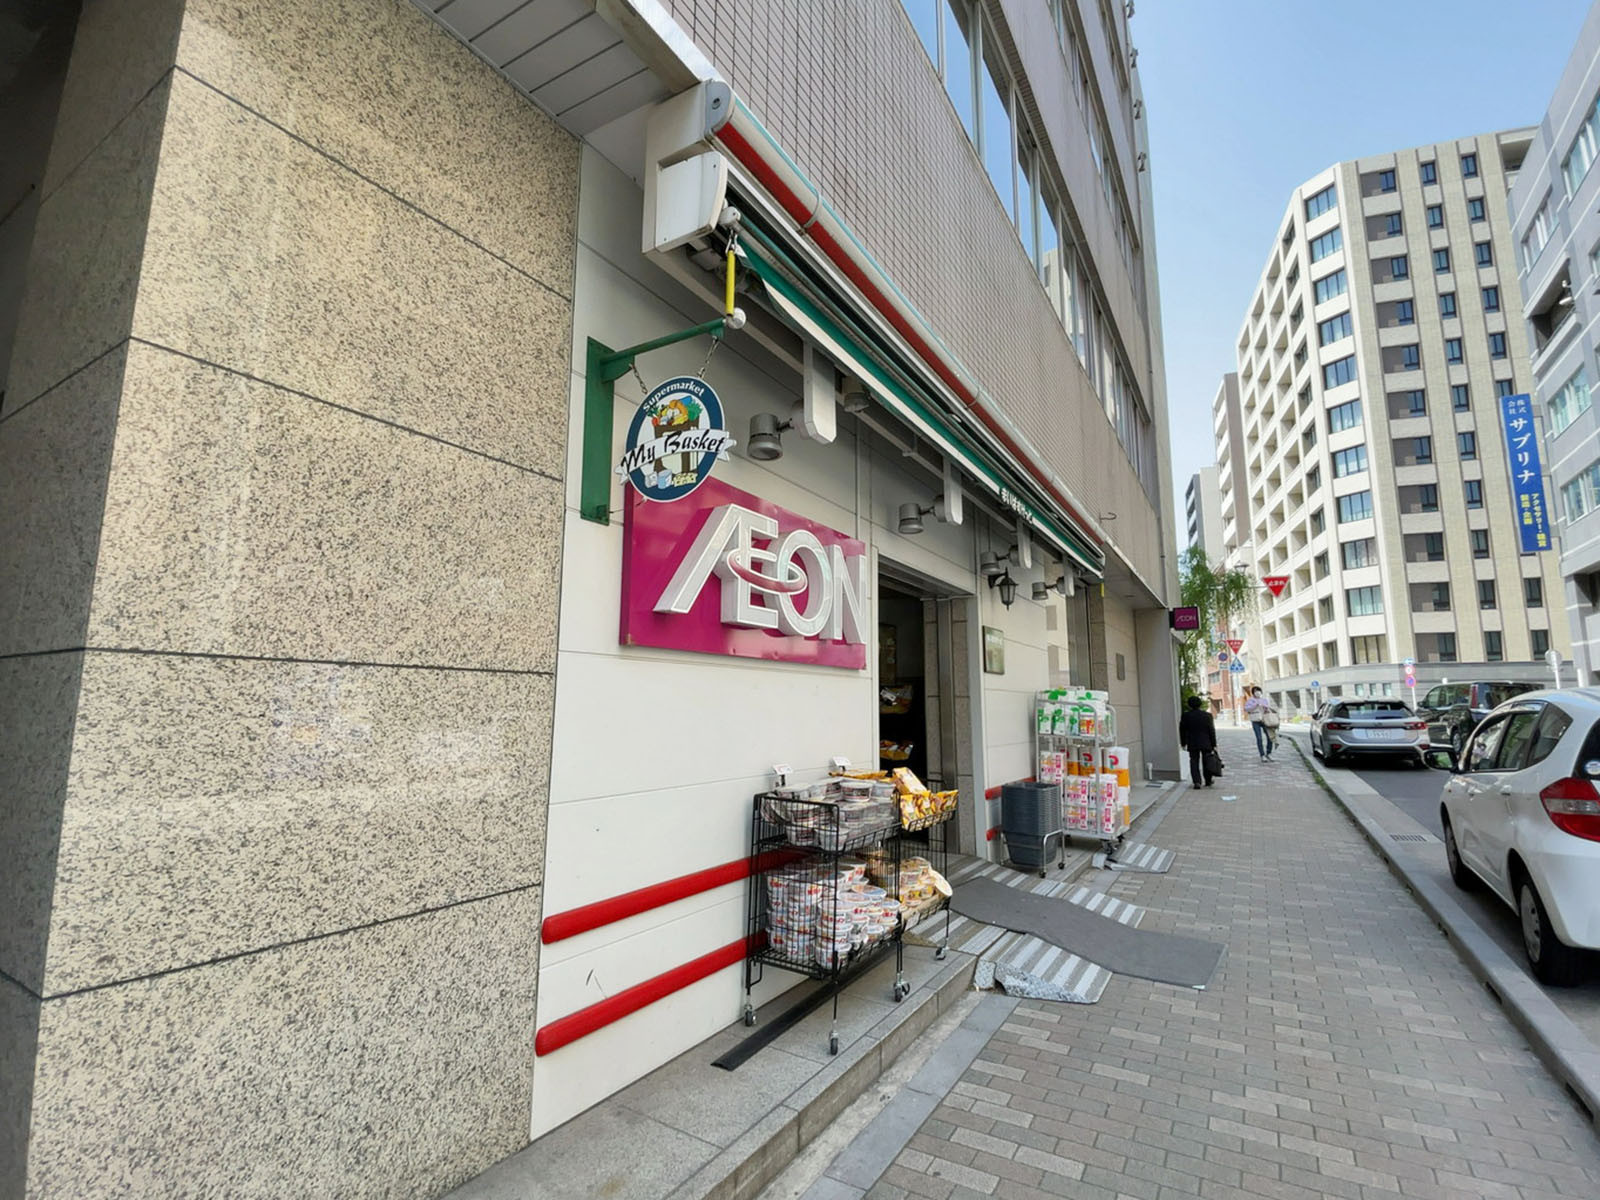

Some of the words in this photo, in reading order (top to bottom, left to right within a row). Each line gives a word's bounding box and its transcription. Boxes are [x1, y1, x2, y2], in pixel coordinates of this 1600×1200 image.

[643, 381, 705, 413] Supermarket
[621, 443, 656, 474] My
[664, 429, 726, 454] Basket
[1510, 418, 1535, 485] サブリナ
